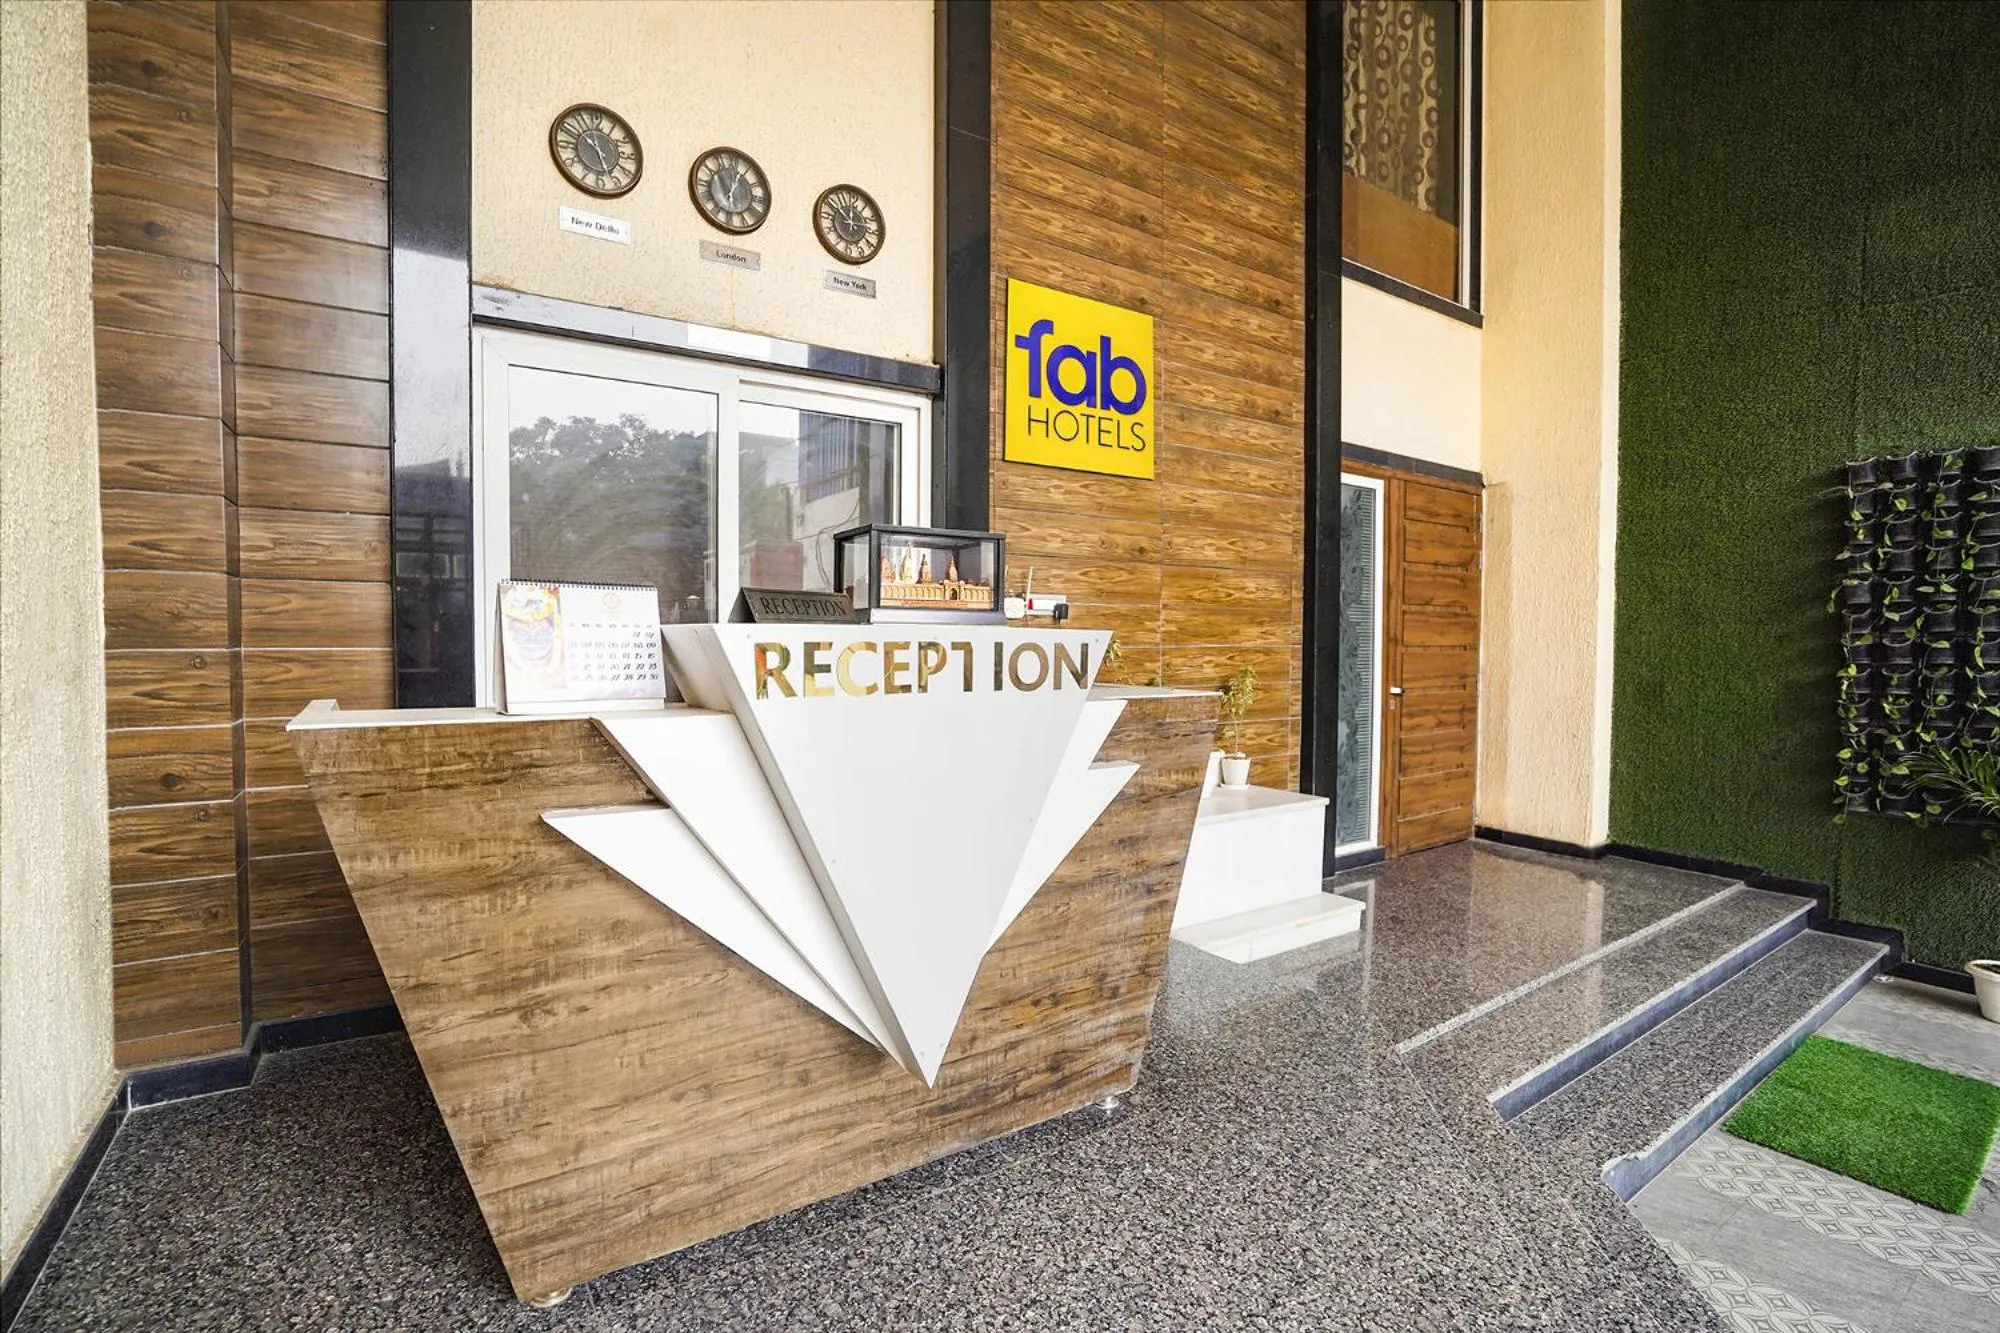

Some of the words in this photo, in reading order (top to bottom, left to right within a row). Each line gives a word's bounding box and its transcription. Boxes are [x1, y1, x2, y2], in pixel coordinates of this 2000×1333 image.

[571, 216, 593, 229] New
[595, 222, 620, 235] Delhi
[715, 249, 747, 263] London
[833, 276, 850, 287] New
[851, 280, 867, 291] York
[1015, 319, 1147, 416] fab
[1027, 405, 1146, 452] HOTELS
[760, 597, 846, 617] RECEPTION
[753, 640, 1089, 701] RECEPTION
